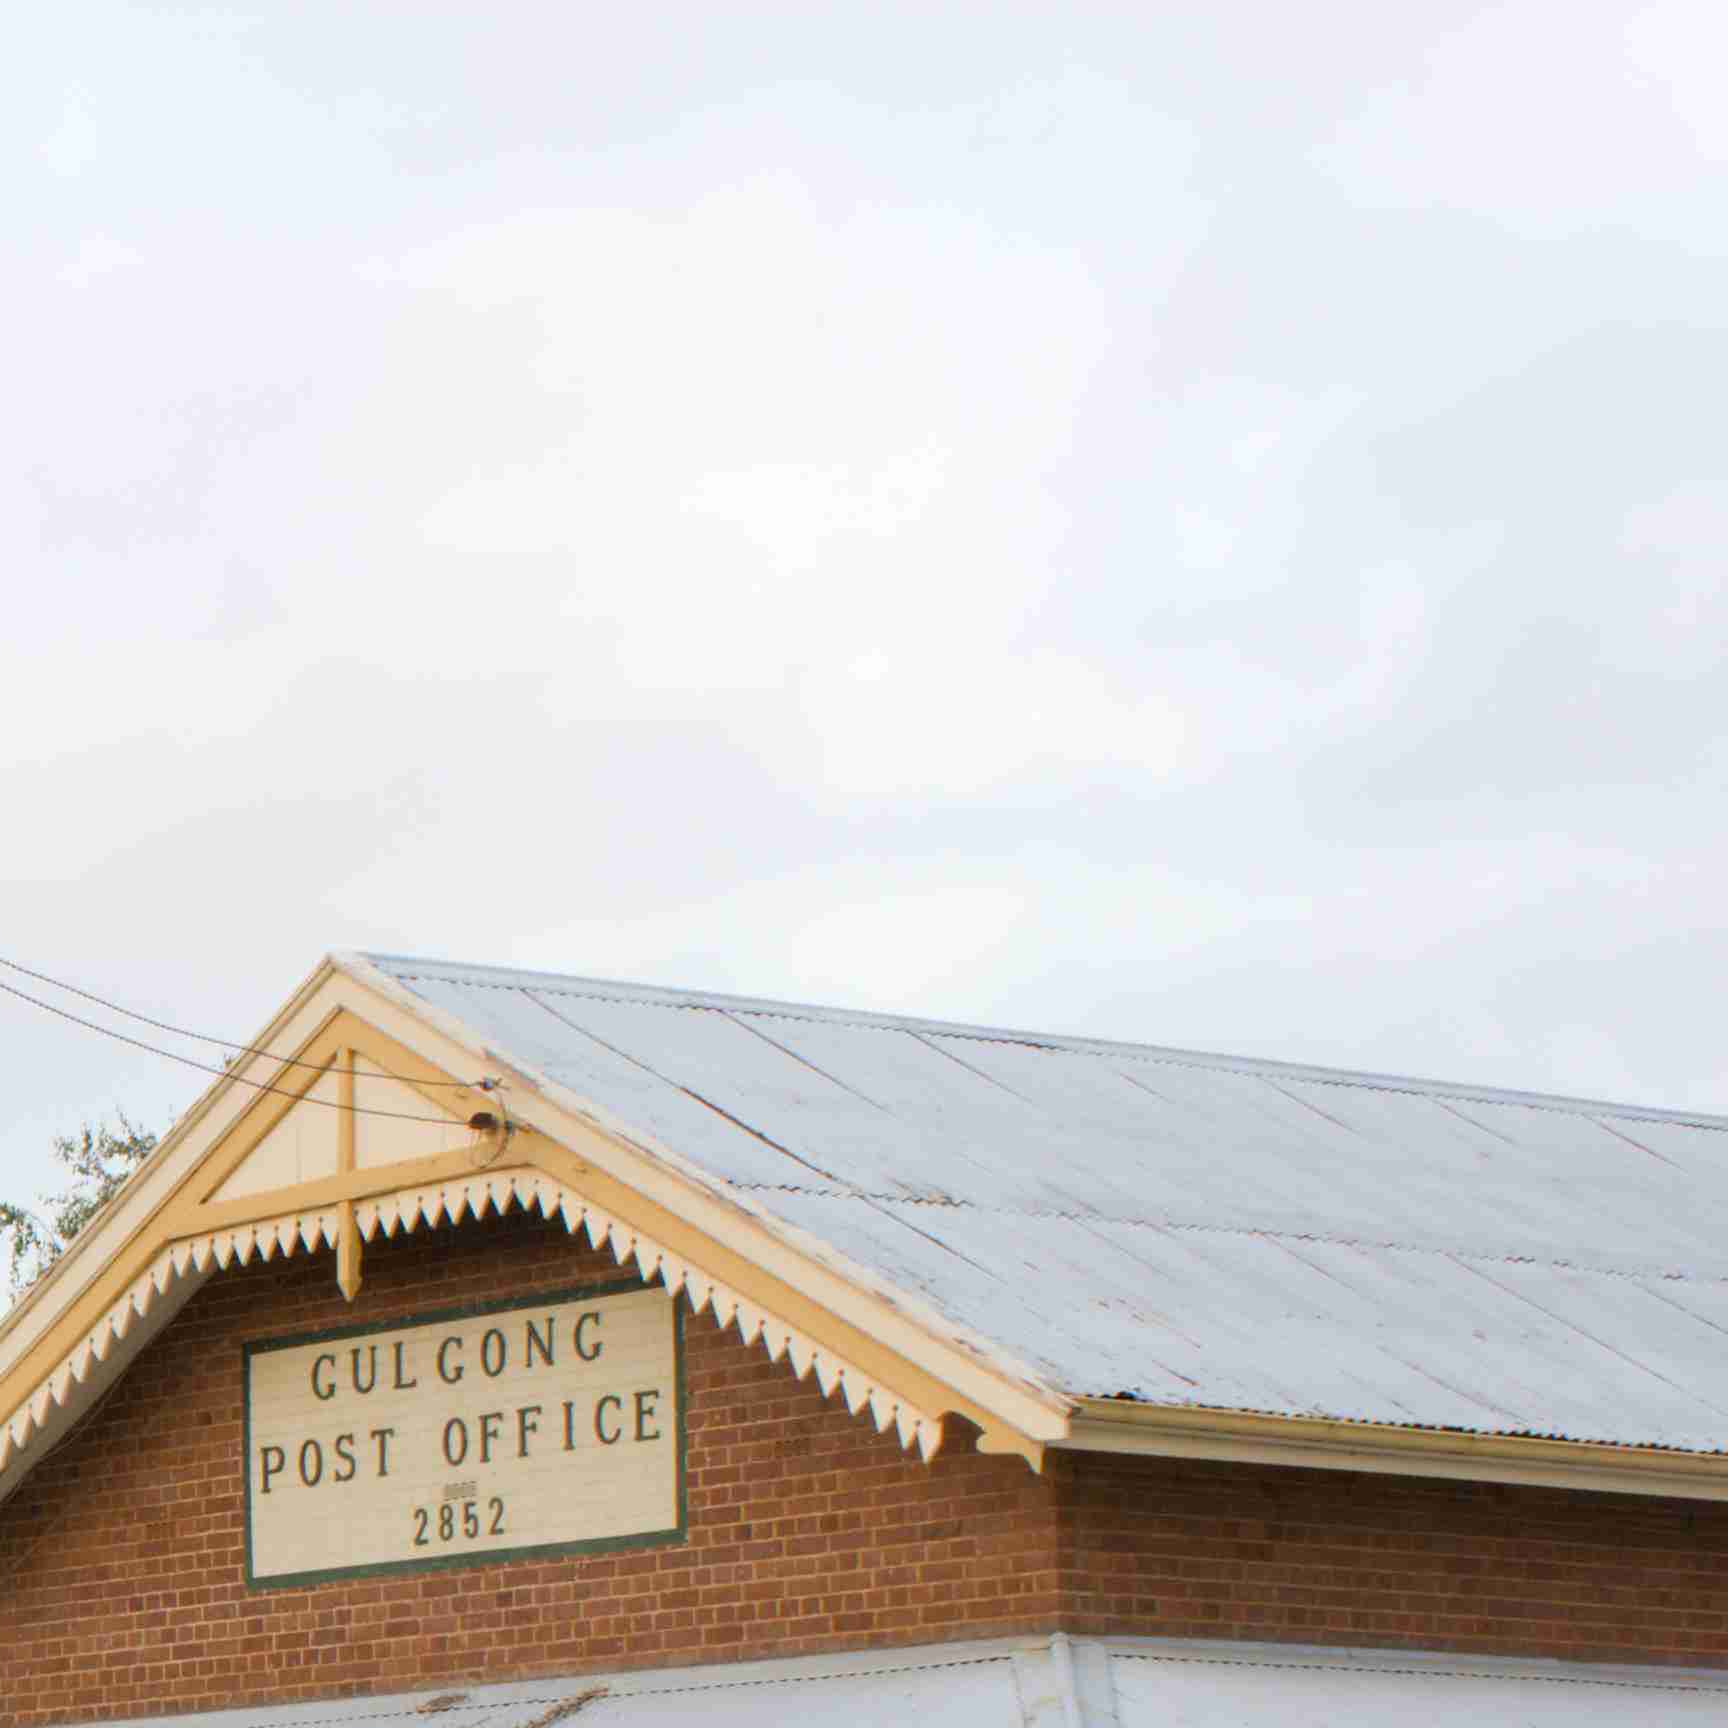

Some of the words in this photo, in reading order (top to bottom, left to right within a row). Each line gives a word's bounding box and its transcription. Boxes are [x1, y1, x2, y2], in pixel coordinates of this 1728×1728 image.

[310, 1311, 604, 1401] GULGONG
[260, 1427, 396, 1494] POST
[442, 1389, 662, 1467] OFFICE
[413, 1496, 505, 1547] 2852
